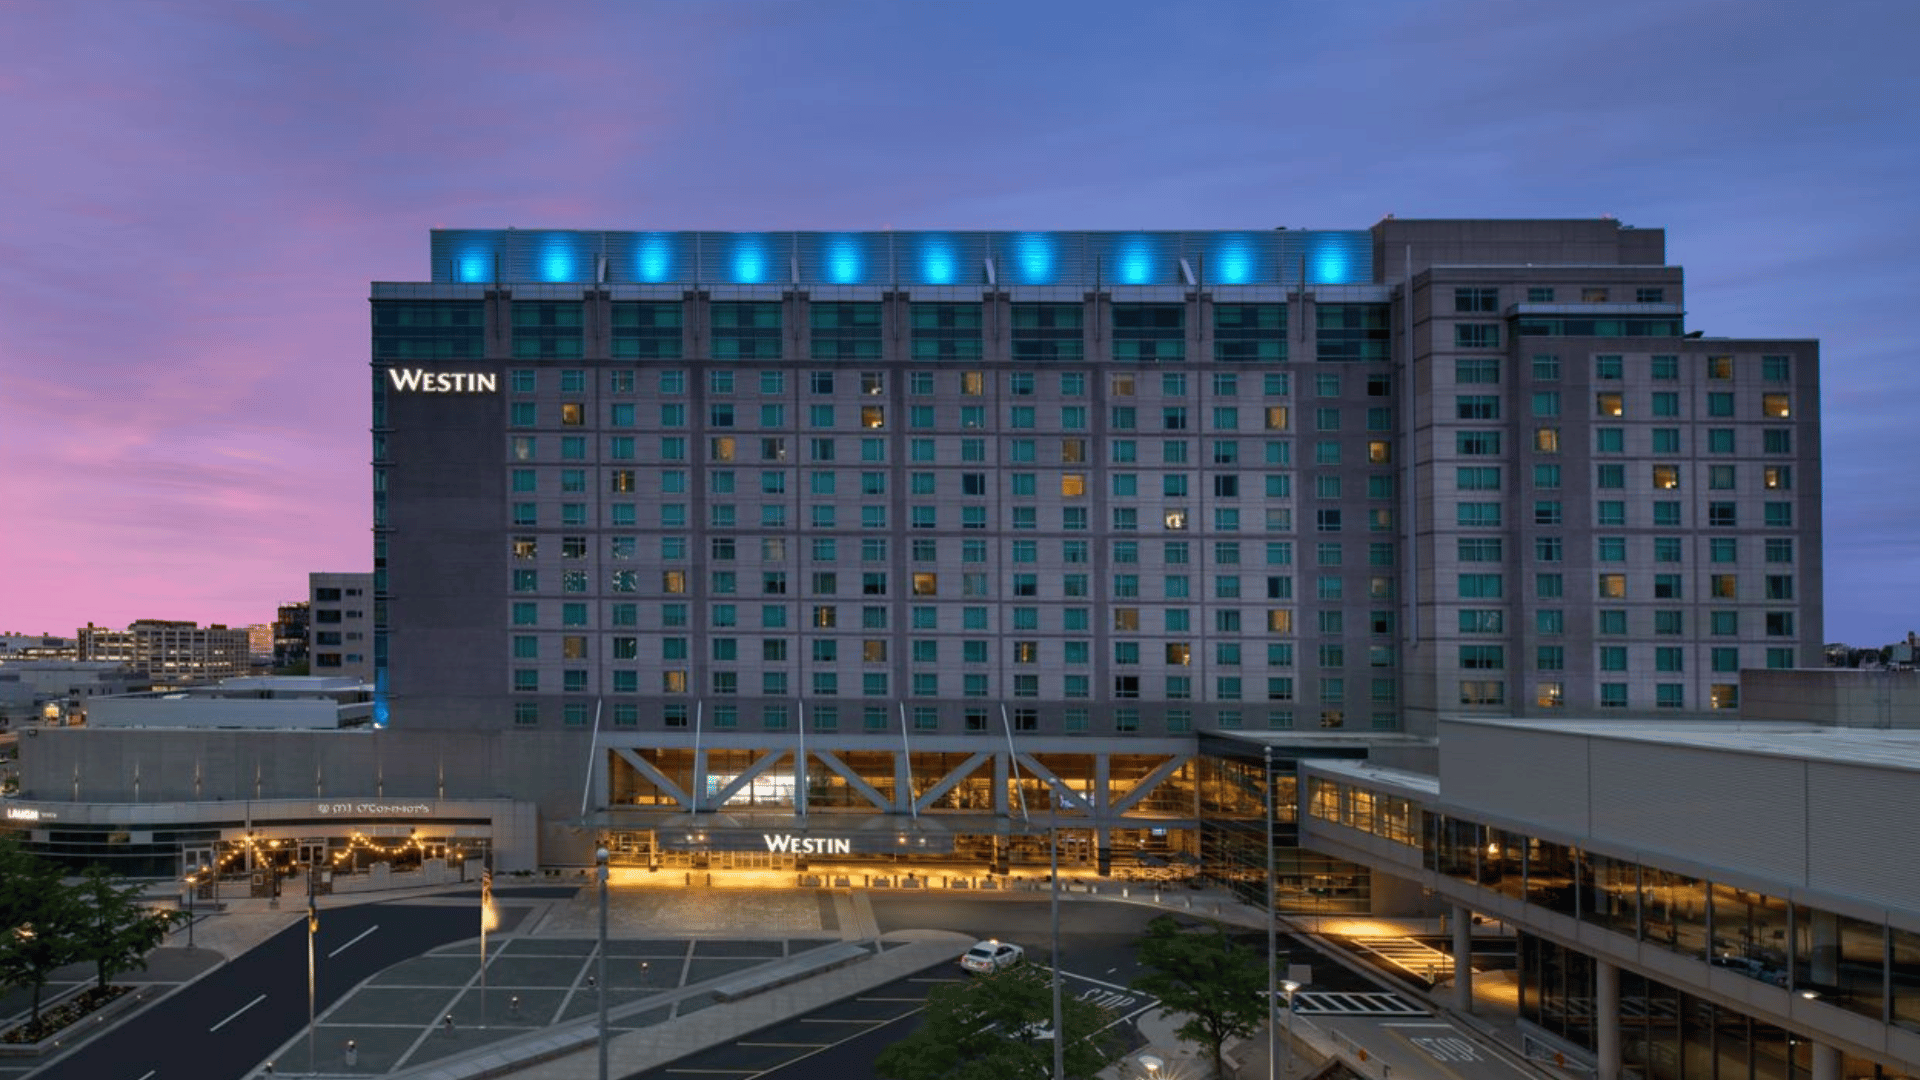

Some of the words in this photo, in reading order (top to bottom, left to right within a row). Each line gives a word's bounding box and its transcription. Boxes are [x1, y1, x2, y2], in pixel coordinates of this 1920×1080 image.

[388, 368, 496, 392] WESTIN
[763, 833, 851, 854] WESTIN
[1073, 988, 1136, 1010] STOP
[1410, 1037, 1485, 1061] STOP
